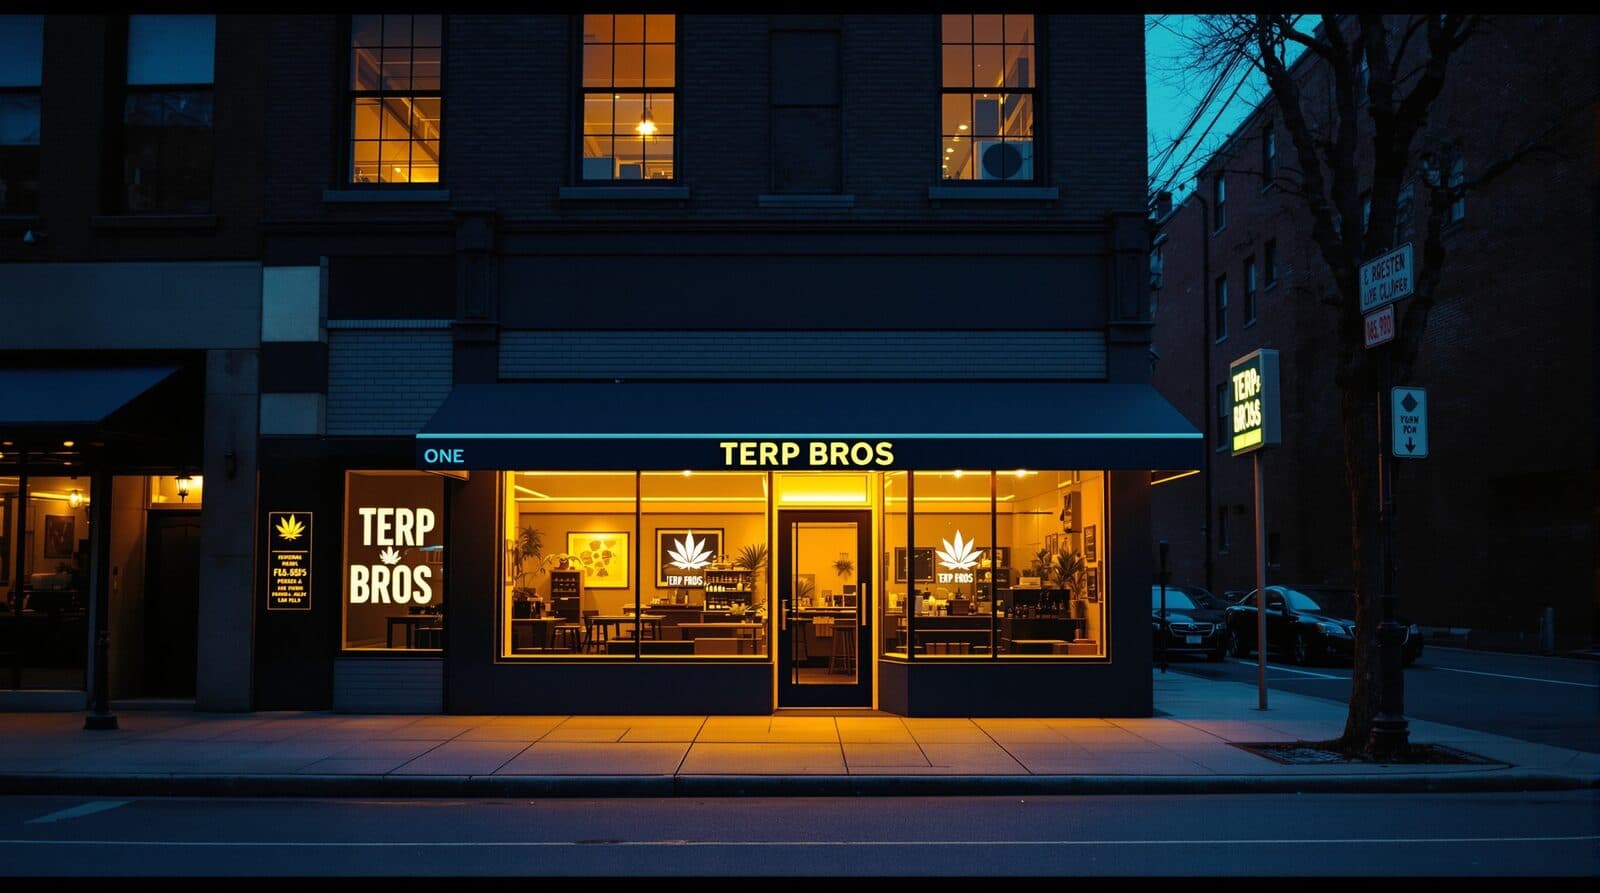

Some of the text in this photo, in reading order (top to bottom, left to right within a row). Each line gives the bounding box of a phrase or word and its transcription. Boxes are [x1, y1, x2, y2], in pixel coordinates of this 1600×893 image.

[424, 448, 464, 463] ONE
[720, 441, 894, 466] TERP BROS
[359, 507, 435, 546] TERP
[350, 564, 432, 604] BROS
